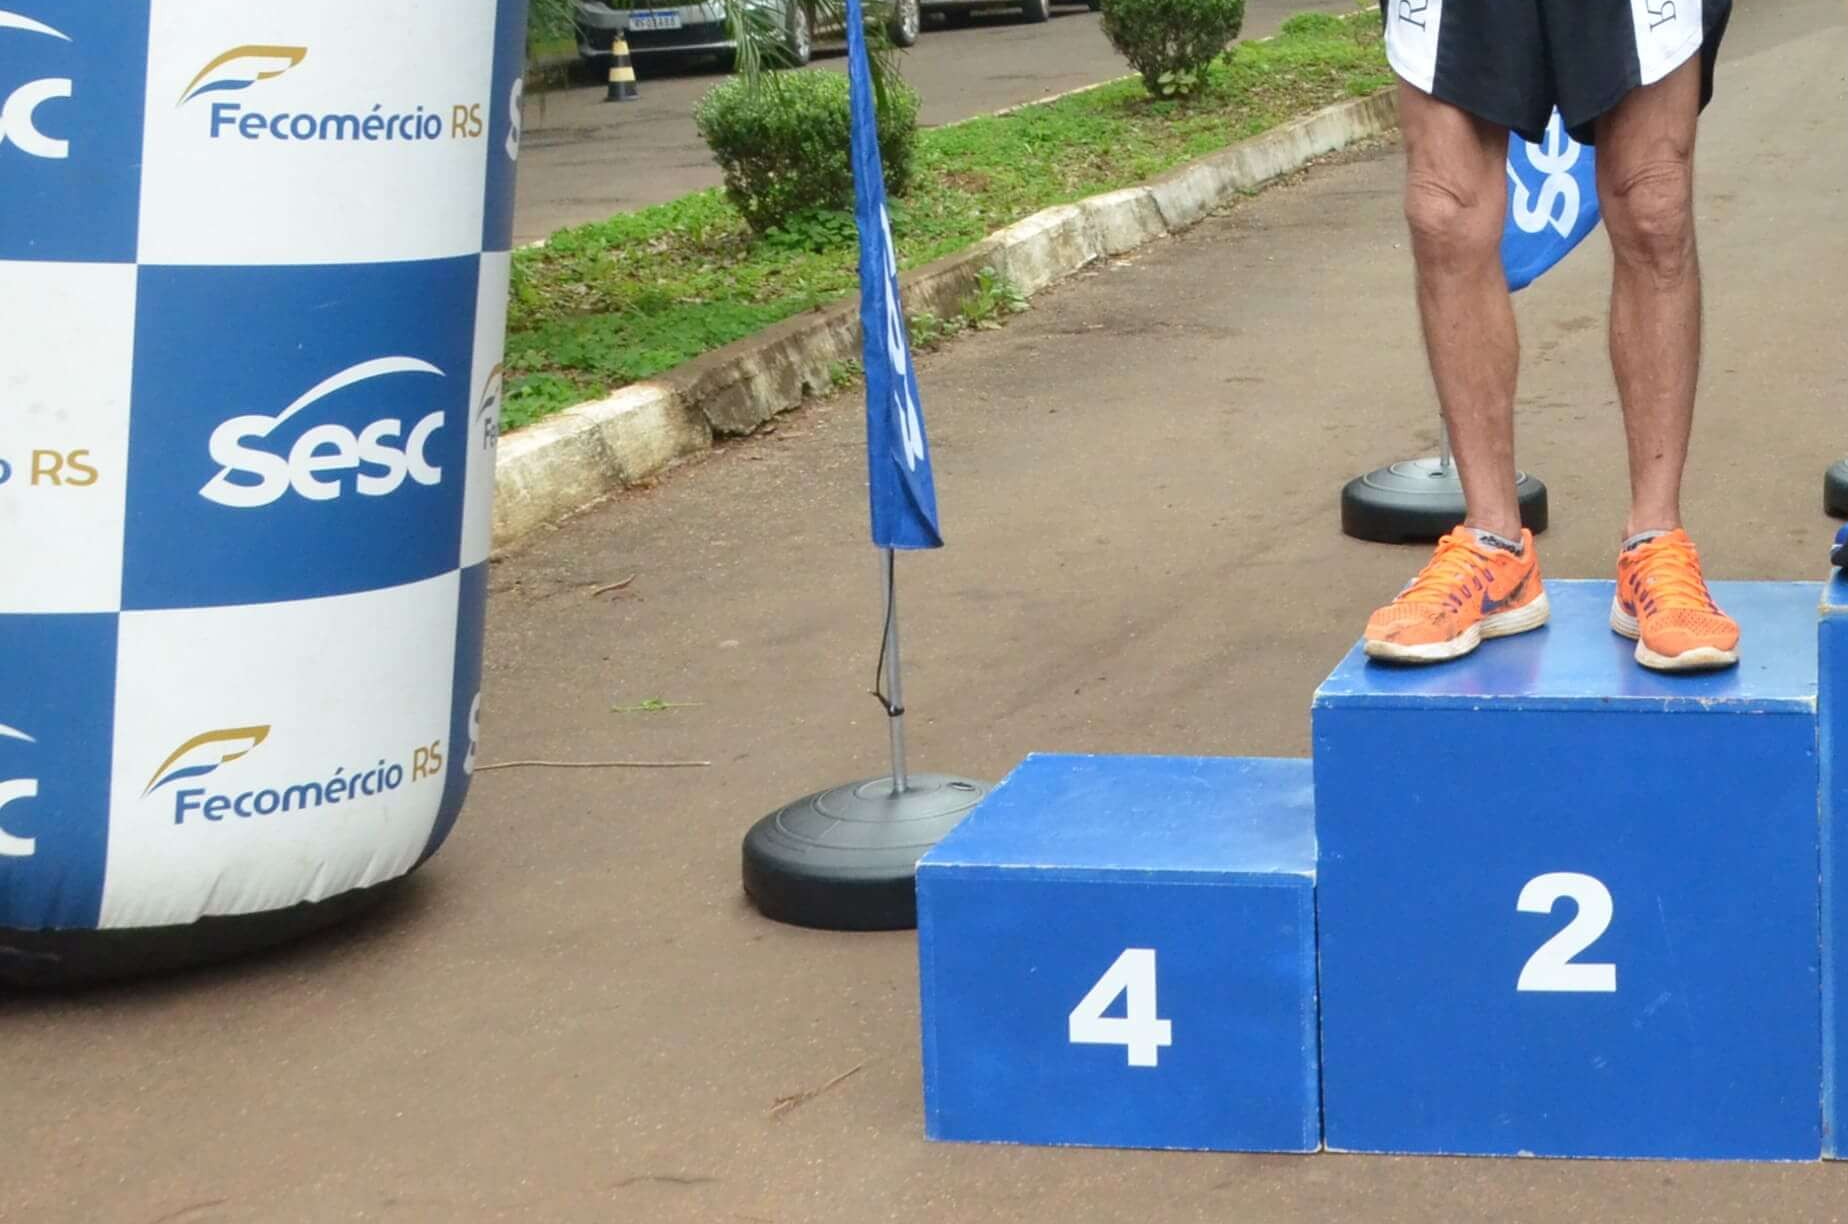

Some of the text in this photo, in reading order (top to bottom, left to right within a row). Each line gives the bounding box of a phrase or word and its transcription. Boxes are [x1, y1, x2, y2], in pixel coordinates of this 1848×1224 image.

[209, 102, 443, 142] Fecomércio
[451, 104, 483, 139] RS
[31, 449, 99, 487] RS
[198, 408, 446, 508] Sesc
[174, 740, 443, 825] Fecomércio RS
[1516, 872, 1617, 993] 2
[1068, 947, 1172, 1067] 4
